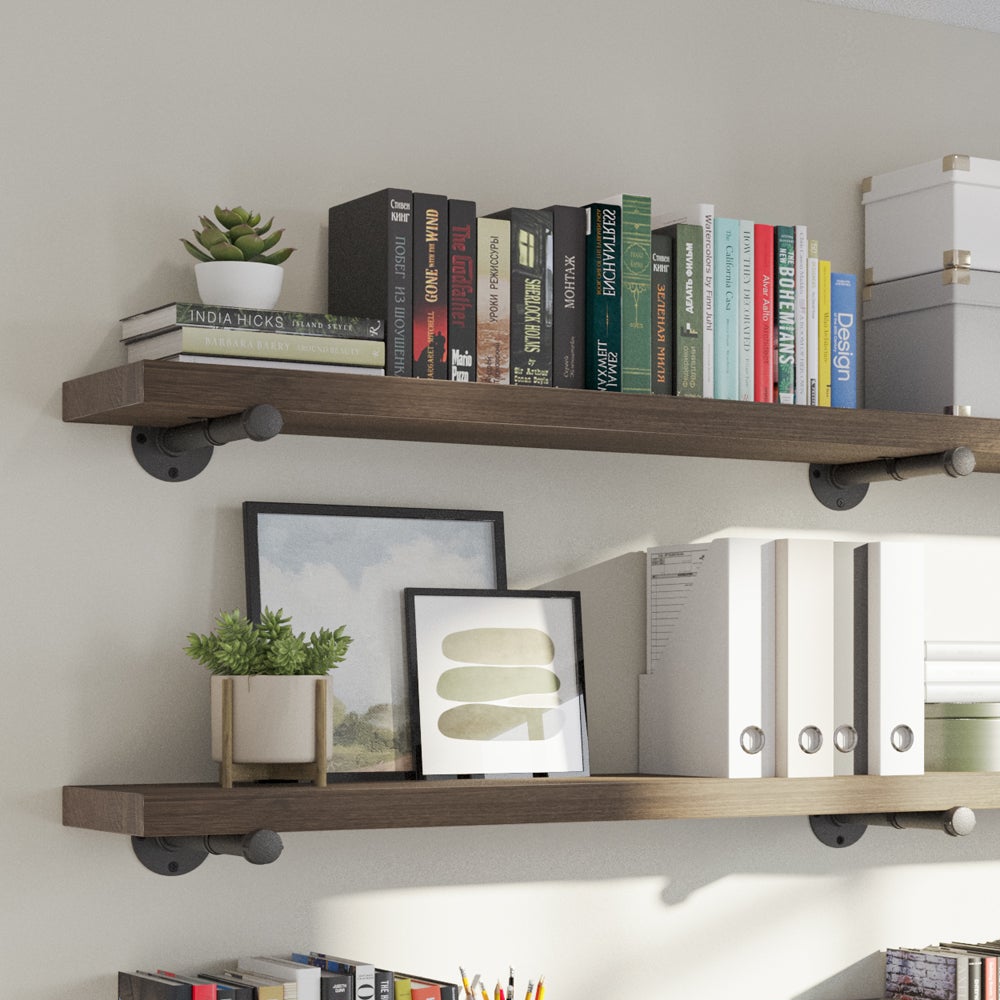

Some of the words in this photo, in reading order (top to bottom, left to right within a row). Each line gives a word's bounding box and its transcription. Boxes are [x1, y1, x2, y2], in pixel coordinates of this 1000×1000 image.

[391, 212, 410, 222] КИНГ
[425, 209, 439, 243] WIND
[452, 224, 471, 251] The
[705, 214, 713, 274] Watercolors
[394, 236, 406, 279] ПОБЕГ
[489, 236, 499, 290] РЕЖИССУРЫ
[685, 242, 693, 277] ФИЛЬМ
[725, 245, 734, 288] California
[394, 286, 406, 303] ИЗ
[425, 269, 439, 303] GONE
[452, 255, 474, 328] Godfather
[564, 256, 576, 309] МОНТАЖ
[685, 278, 694, 314] ДЕЛАТЬ
[705, 276, 712, 287] by
[762, 274, 770, 296] Alvar
[489, 294, 499, 323] УРОКИ
[524, 278, 541, 322] SHERLOCK
[657, 284, 666, 342] ЗЕЛЕНАЯ
[725, 290, 734, 311] Casa
[762, 298, 770, 321] Aalto
[778, 266, 795, 365] BOHEMIANS
[189, 309, 232, 325] INDIA
[237, 314, 284, 328] HICKS
[292, 320, 324, 329] ISLAND
[705, 311, 713, 331] Juhl
[204, 336, 253, 349] BARBARA
[451, 348, 472, 367] Mario
[833, 313, 854, 381] Design
[657, 347, 666, 383] МИЛЯ
[380, 980, 389, 994] THE
